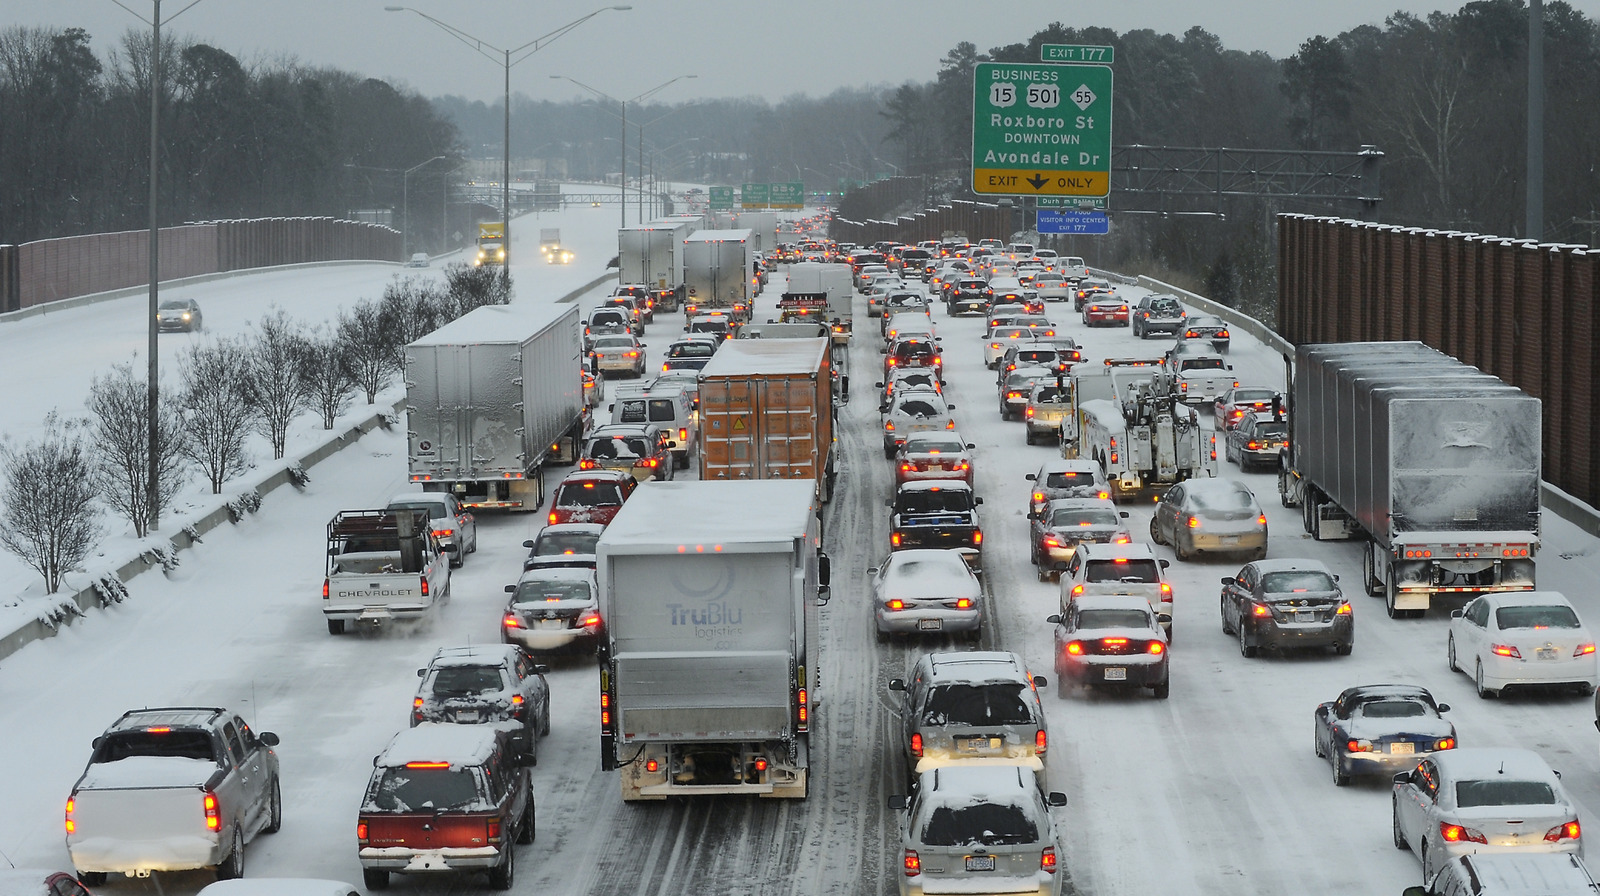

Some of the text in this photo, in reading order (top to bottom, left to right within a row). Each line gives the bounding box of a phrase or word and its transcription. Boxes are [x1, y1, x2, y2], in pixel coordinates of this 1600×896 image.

[1049, 47, 1106, 60] EXIT 177
[991, 70, 1059, 81] BUSINESS
[994, 88, 1091, 104] 15 501 55
[991, 113, 1094, 129] Roxboro St
[1004, 133, 1080, 145] DOWNTOWN
[984, 150, 1100, 166] Avondale Dr
[989, 175, 1093, 188] EXIT ONLY
[338, 589, 413, 598] CHEVROLET
[665, 601, 743, 625] TruBlu
[695, 625, 743, 641] logistics
